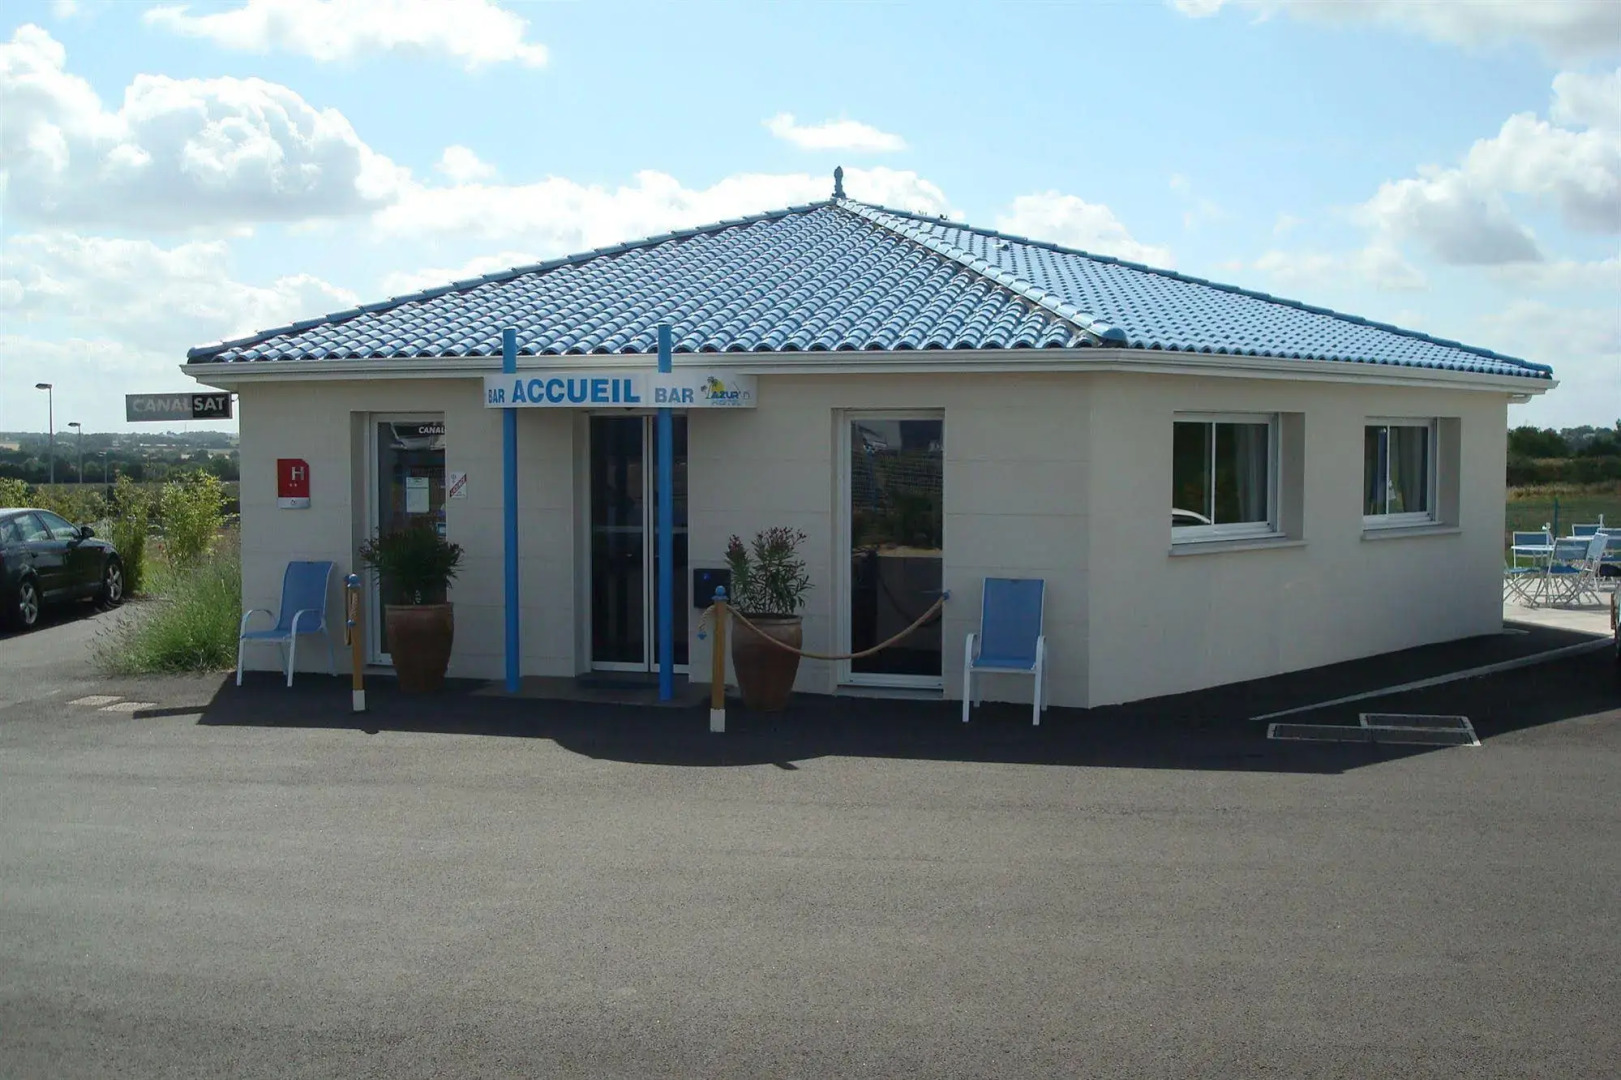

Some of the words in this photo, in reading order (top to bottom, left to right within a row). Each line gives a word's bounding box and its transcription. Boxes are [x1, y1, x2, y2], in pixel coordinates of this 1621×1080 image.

[488, 389, 505, 403] BAR
[512, 379, 641, 403] ACCUEIL
[655, 388, 694, 403] BAR
[291, 466, 304, 480] H
